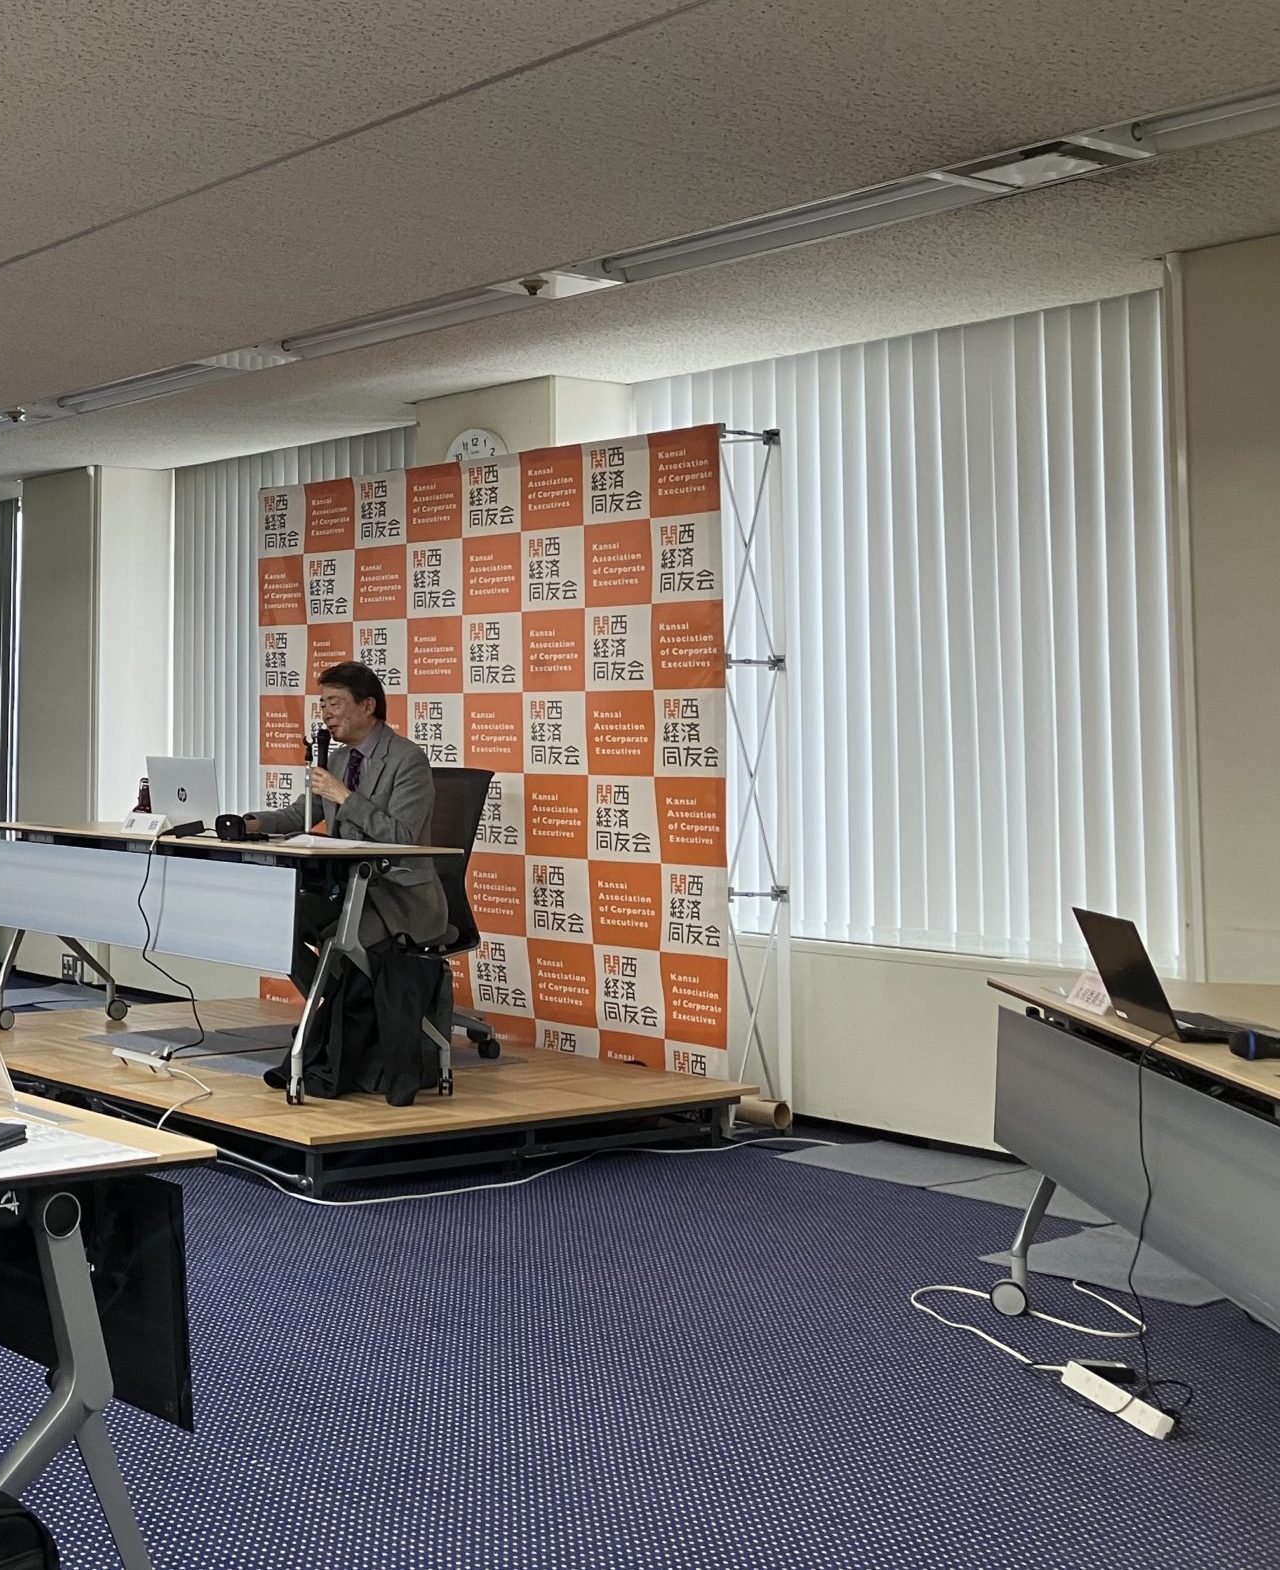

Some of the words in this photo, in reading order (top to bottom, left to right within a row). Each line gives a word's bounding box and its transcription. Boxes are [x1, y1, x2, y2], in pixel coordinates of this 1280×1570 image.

[471, 438, 478, 446] 12
[455, 453, 462, 462] 10
[490, 448, 495, 456] 2
[591, 447, 625, 469] 関西
[658, 449, 686, 459] Kansai
[527, 467, 553, 476] Kansai
[658, 458, 709, 471] Association
[469, 464, 498, 485] 関西
[591, 470, 624, 492] 経済
[658, 475, 668, 484] of
[669, 471, 712, 484] Corporate
[528, 476, 573, 488] Association
[361, 480, 387, 500] 関西
[469, 487, 498, 506] 経済
[527, 490, 537, 500] of
[538, 488, 576, 500] Corporate
[658, 484, 705, 496] Executives
[265, 494, 288, 512] 関西
[528, 500, 570, 511] Executives
[592, 491, 642, 514] 同友会
[361, 501, 386, 519] 経済
[469, 506, 514, 528] 同友会
[265, 513, 286, 530] 経済
[361, 519, 400, 539] 同友会
[660, 523, 695, 546] 関西
[265, 530, 299, 549] 同友会
[592, 542, 619, 551] Kansai
[529, 537, 560, 558] 関西
[413, 549, 441, 568] 関西
[469, 554, 493, 562] Kansai
[592, 552, 641, 563] Association
[661, 547, 694, 569] 経済
[310, 559, 336, 577] 関西
[470, 563, 512, 573] Association
[529, 560, 560, 580] 経済
[592, 566, 602, 575] of
[603, 564, 646, 576] Corporate
[414, 570, 440, 588] 経済
[470, 576, 478, 584] of
[479, 574, 515, 585] Corporate
[592, 577, 638, 587] Executives
[660, 569, 714, 593] 同友会
[310, 579, 334, 596] 経済
[470, 587, 509, 596] Executives
[529, 580, 577, 602] 同友会
[311, 597, 347, 615] 同友会
[414, 589, 456, 609] 同友会
[470, 622, 500, 641] 関西
[593, 615, 627, 635] 関西
[659, 622, 689, 631] Kansai
[360, 628, 387, 646] 関西
[530, 629, 555, 637] Kansai
[660, 634, 713, 644] Association
[265, 633, 288, 649] 関西
[530, 640, 575, 649] Association
[594, 638, 626, 658] 経済
[470, 644, 499, 662] 経済
[530, 653, 538, 661] of
[539, 653, 578, 662] Corporate
[660, 648, 670, 656] of
[672, 647, 717, 656] Corporate
[265, 652, 286, 668] 経済
[423, 657, 457, 665] Corporate
[661, 660, 711, 668] Executives
[470, 665, 516, 684] 同友会
[530, 664, 571, 672] Executives
[593, 660, 644, 681] 同友会
[265, 671, 299, 687] 同友会
[415, 702, 443, 720] 関西
[471, 711, 495, 719] Kansai
[530, 701, 562, 720] 関西
[594, 710, 622, 718] Kansai
[664, 698, 699, 719] 関西
[415, 723, 442, 740] 経済
[471, 722, 514, 730] Association
[531, 723, 562, 742] 経済
[594, 722, 645, 731] Association
[664, 722, 700, 743] 経済
[471, 734, 479, 742] of
[480, 734, 517, 743] Corporate
[606, 735, 648, 744] Corporate
[471, 745, 511, 754] Executives
[531, 746, 579, 765] 同友会
[595, 747, 641, 755] Executives
[663, 746, 719, 767] 同友会
[266, 773, 292, 790] 関西
[532, 793, 558, 801] Kansai
[597, 784, 629, 805] 関西
[666, 797, 696, 806] Kansai
[532, 805, 578, 814] Association
[668, 810, 716, 819] Association
[532, 817, 541, 825] of
[542, 817, 581, 827] Corporate
[596, 808, 629, 828] 経済
[533, 829, 574, 838] Executives
[668, 823, 678, 831] of
[680, 823, 719, 832] Corporate
[596, 831, 651, 853] 同友会
[669, 836, 713, 845] Executives
[473, 871, 497, 879] Kansai
[533, 865, 564, 886] 関西
[473, 883, 516, 892] Association
[598, 881, 627, 890] Kansai
[671, 873, 703, 896] 関西
[473, 894, 481, 902] of
[483, 895, 520, 905] Corporate
[533, 887, 564, 908] 経済
[599, 894, 652, 903] Association
[473, 906, 514, 916] Executives
[599, 905, 609, 913] of
[611, 906, 655, 917] Corporate
[670, 898, 701, 920] 経済
[534, 910, 584, 934] 同友会
[600, 918, 648, 928] Executives
[668, 922, 720, 947] 同友会
[476, 941, 505, 962] 関西
[537, 958, 563, 967] Kansai
[604, 955, 637, 978] 関西
[477, 962, 507, 984] 経済
[538, 970, 586, 982] Association
[670, 973, 699, 983] Kansai
[538, 981, 547, 989] of
[548, 983, 590, 994] Corporate
[604, 977, 636, 1001] 経済
[672, 986, 719, 999] Association
[479, 984, 526, 1008] 同友会
[539, 994, 583, 1006] Executives
[672, 999, 681, 1007] of
[683, 1000, 722, 1013] Corporate
[604, 1002, 657, 1027] 同友会
[672, 1011, 716, 1025] Executives
[544, 1029, 576, 1052] 関西
[608, 1051, 635, 1061] Kansai
[674, 1051, 706, 1076] 関西
